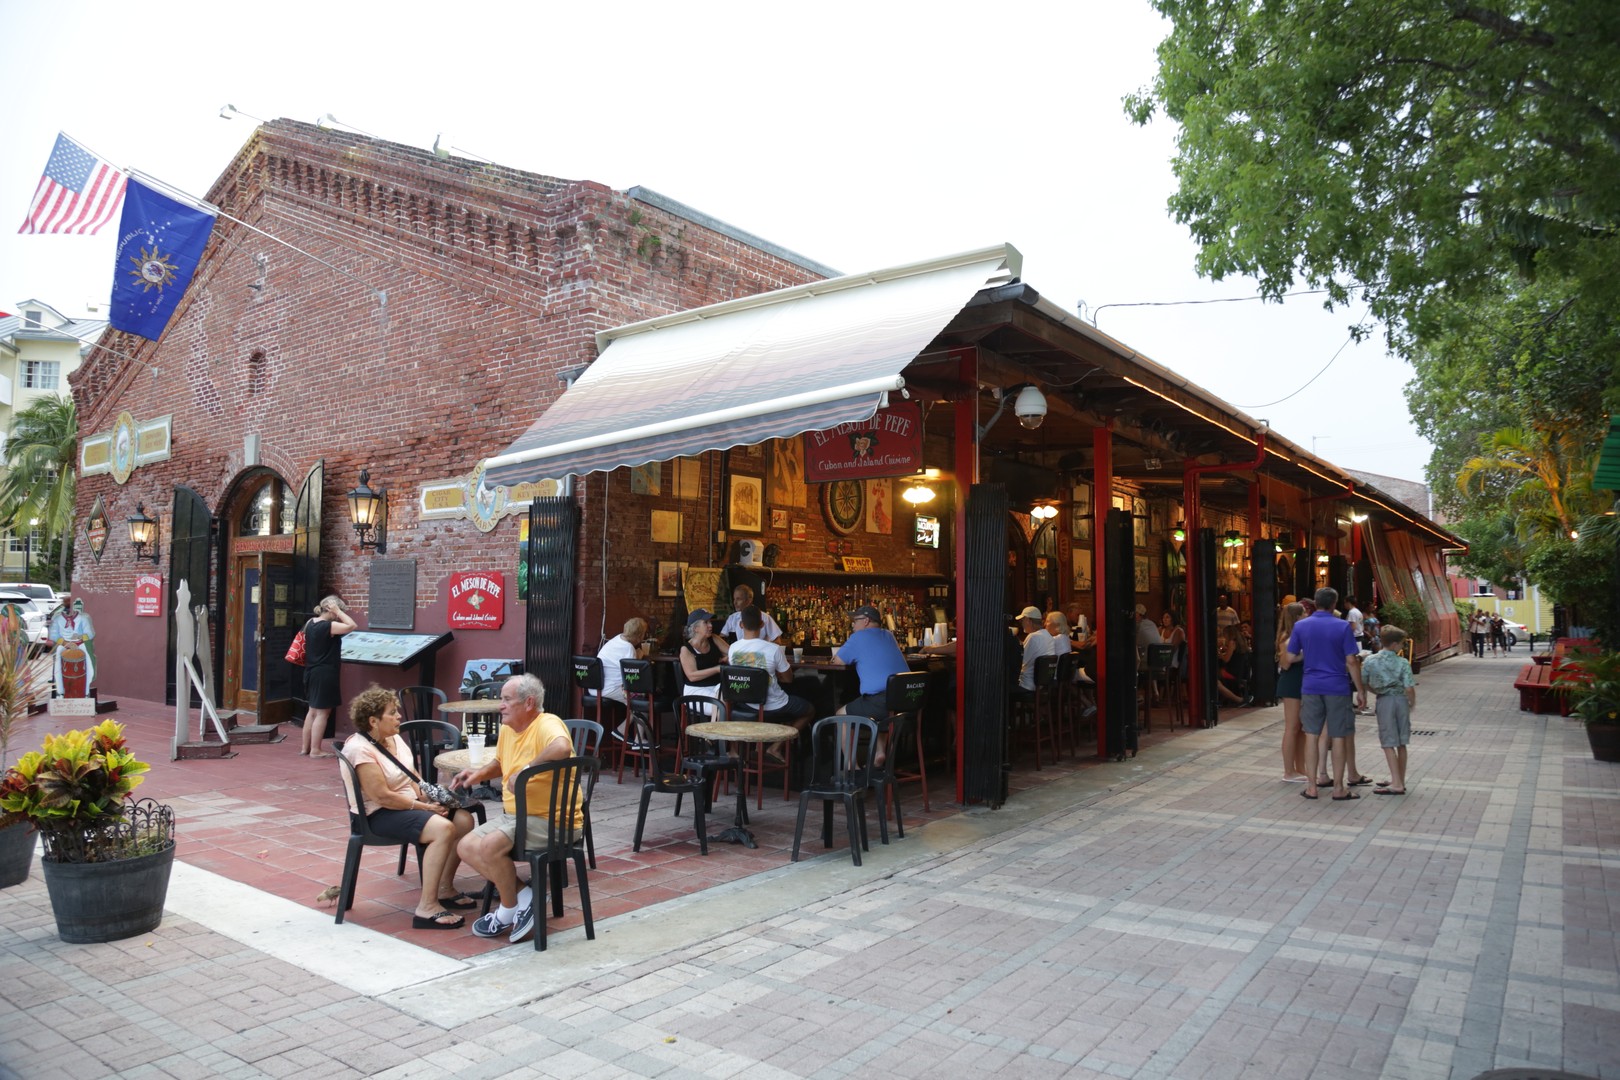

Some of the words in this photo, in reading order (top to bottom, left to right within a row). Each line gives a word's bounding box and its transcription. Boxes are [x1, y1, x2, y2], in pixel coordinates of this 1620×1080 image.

[813, 430, 829, 447] EL
[869, 413, 883, 430] DE
[885, 414, 911, 437] PEPE
[818, 460, 843, 471] Cuban
[843, 458, 857, 468] and
[857, 455, 883, 467] Island
[884, 454, 911, 464] Cuisine
[520, 481, 550, 489] SPANISH
[517, 491, 532, 499] KEY
[532, 489, 551, 498] WEST
[856, 558, 870, 567] NOT
[451, 584, 461, 599] EL
[460, 577, 480, 593] MESON
[480, 577, 488, 590] DE
[487, 579, 501, 598] PEPE
[484, 612, 497, 621] Cuisine
[729, 682, 750, 693] Mojito
